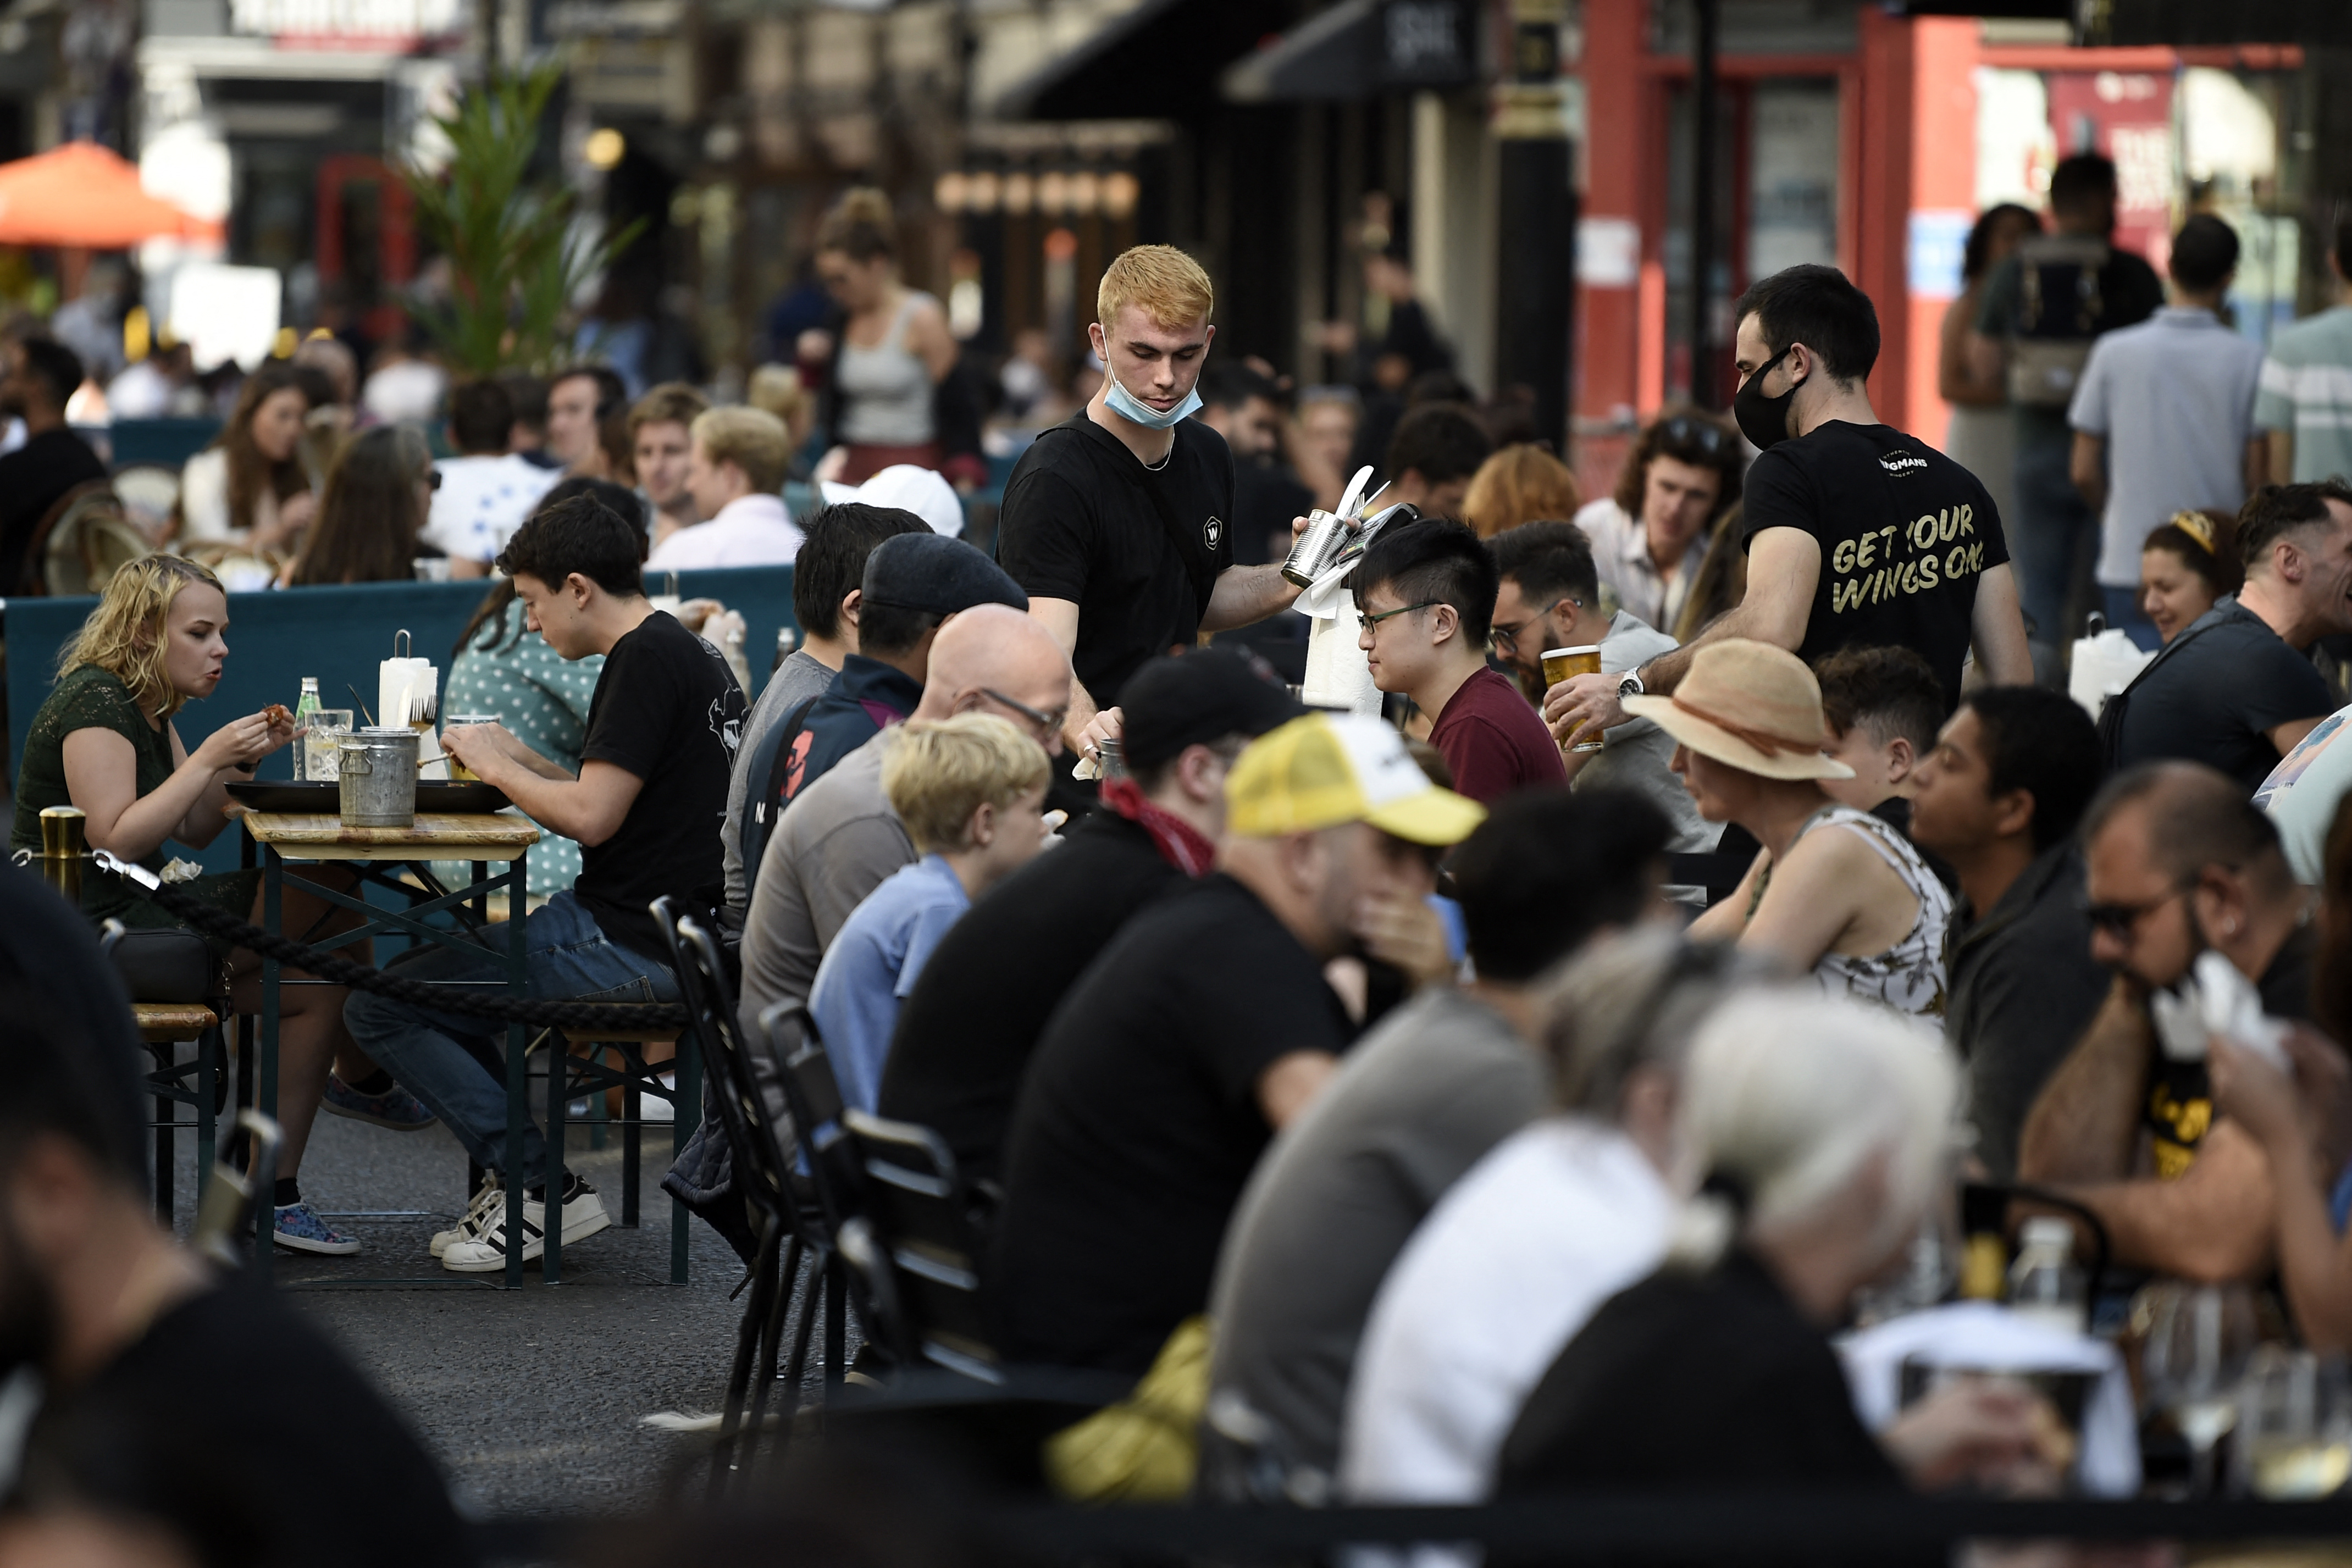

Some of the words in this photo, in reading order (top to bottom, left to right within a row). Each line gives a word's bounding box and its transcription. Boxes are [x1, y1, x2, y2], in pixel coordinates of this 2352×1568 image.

[1883, 450, 1910, 459] UTHENTIC
[1879, 458, 1928, 471] INGMANS
[1208, 526, 1217, 541] W
[1833, 525, 1897, 574] GET
[1833, 554, 1939, 614] WINGS
